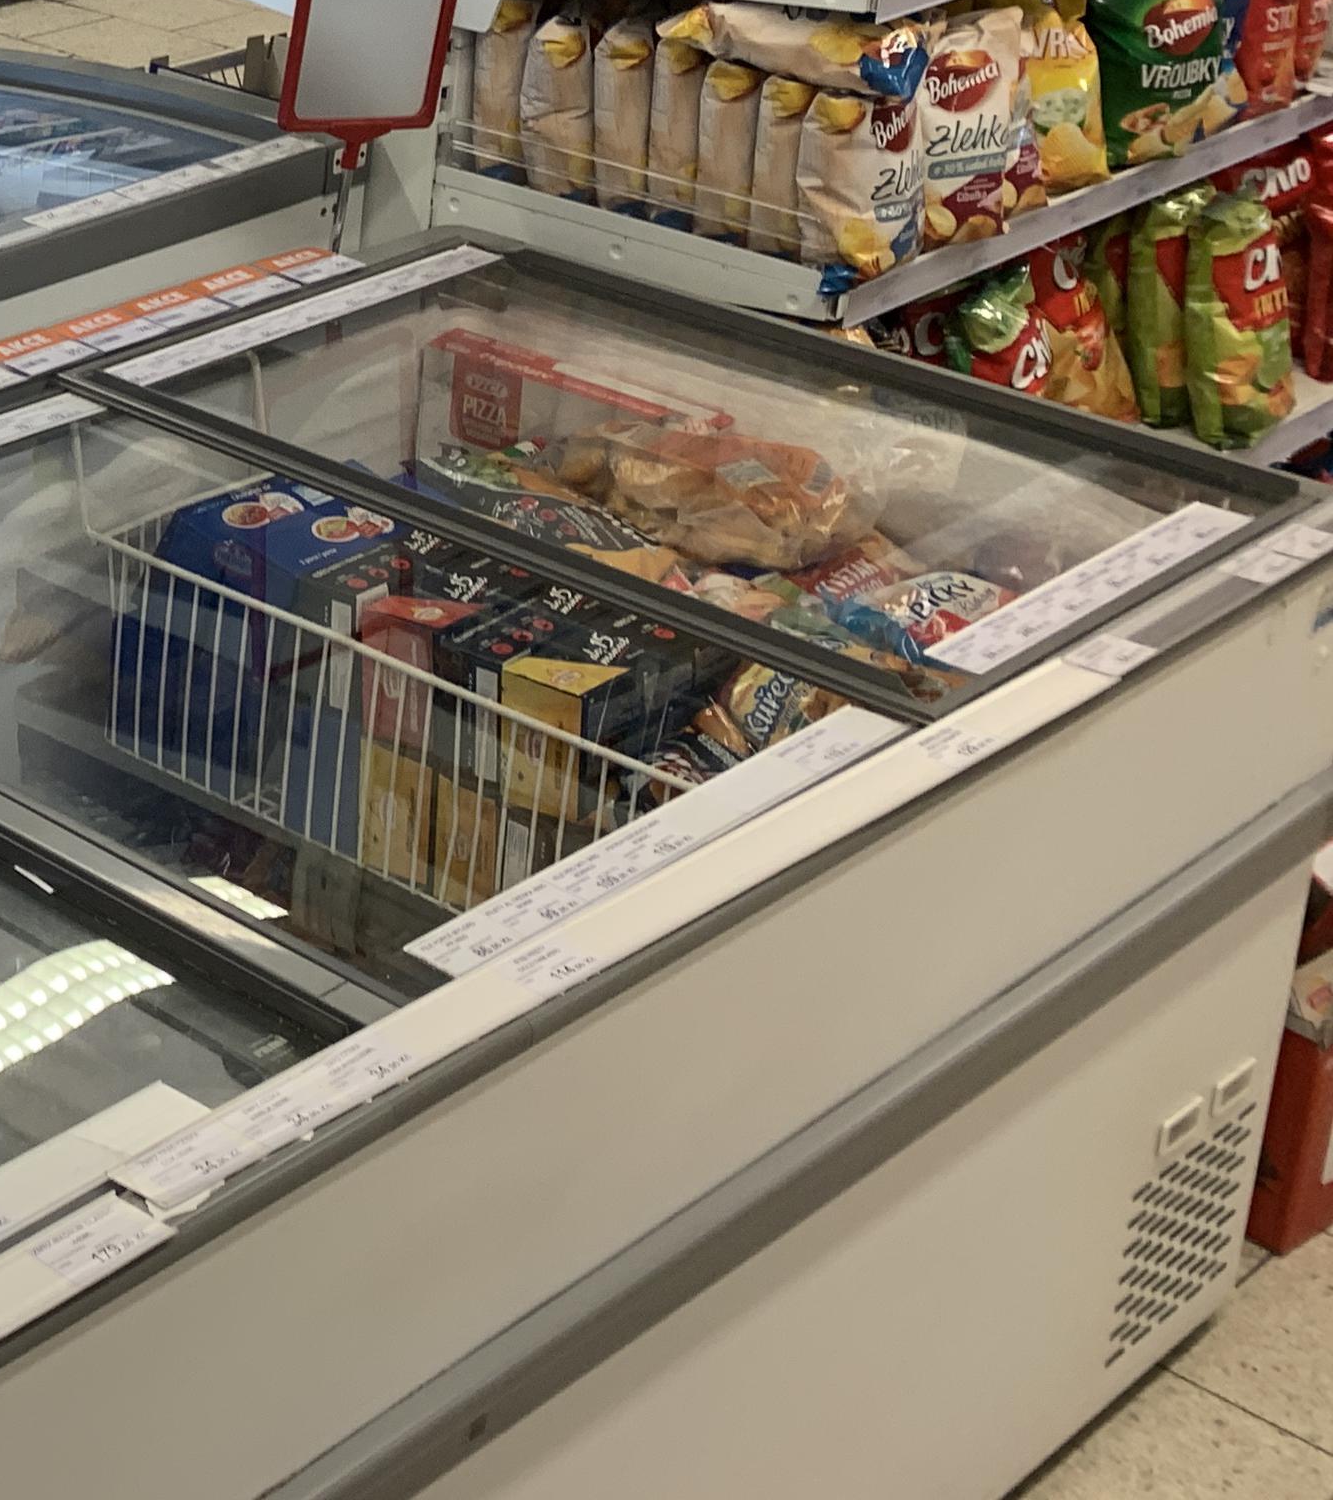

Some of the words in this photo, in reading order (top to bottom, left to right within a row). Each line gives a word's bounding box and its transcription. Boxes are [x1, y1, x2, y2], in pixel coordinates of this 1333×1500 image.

[1145, 4, 1218, 49] Bohemia
[927, 61, 999, 104] Bohemia
[269, 250, 321, 270] AKCE
[202, 270, 254, 294] AKCE
[135, 289, 191, 316] AKCE
[69, 311, 124, 339] AKCE
[462, 396, 507, 427] PIZZA
[910, 580, 974, 620] PICKY
